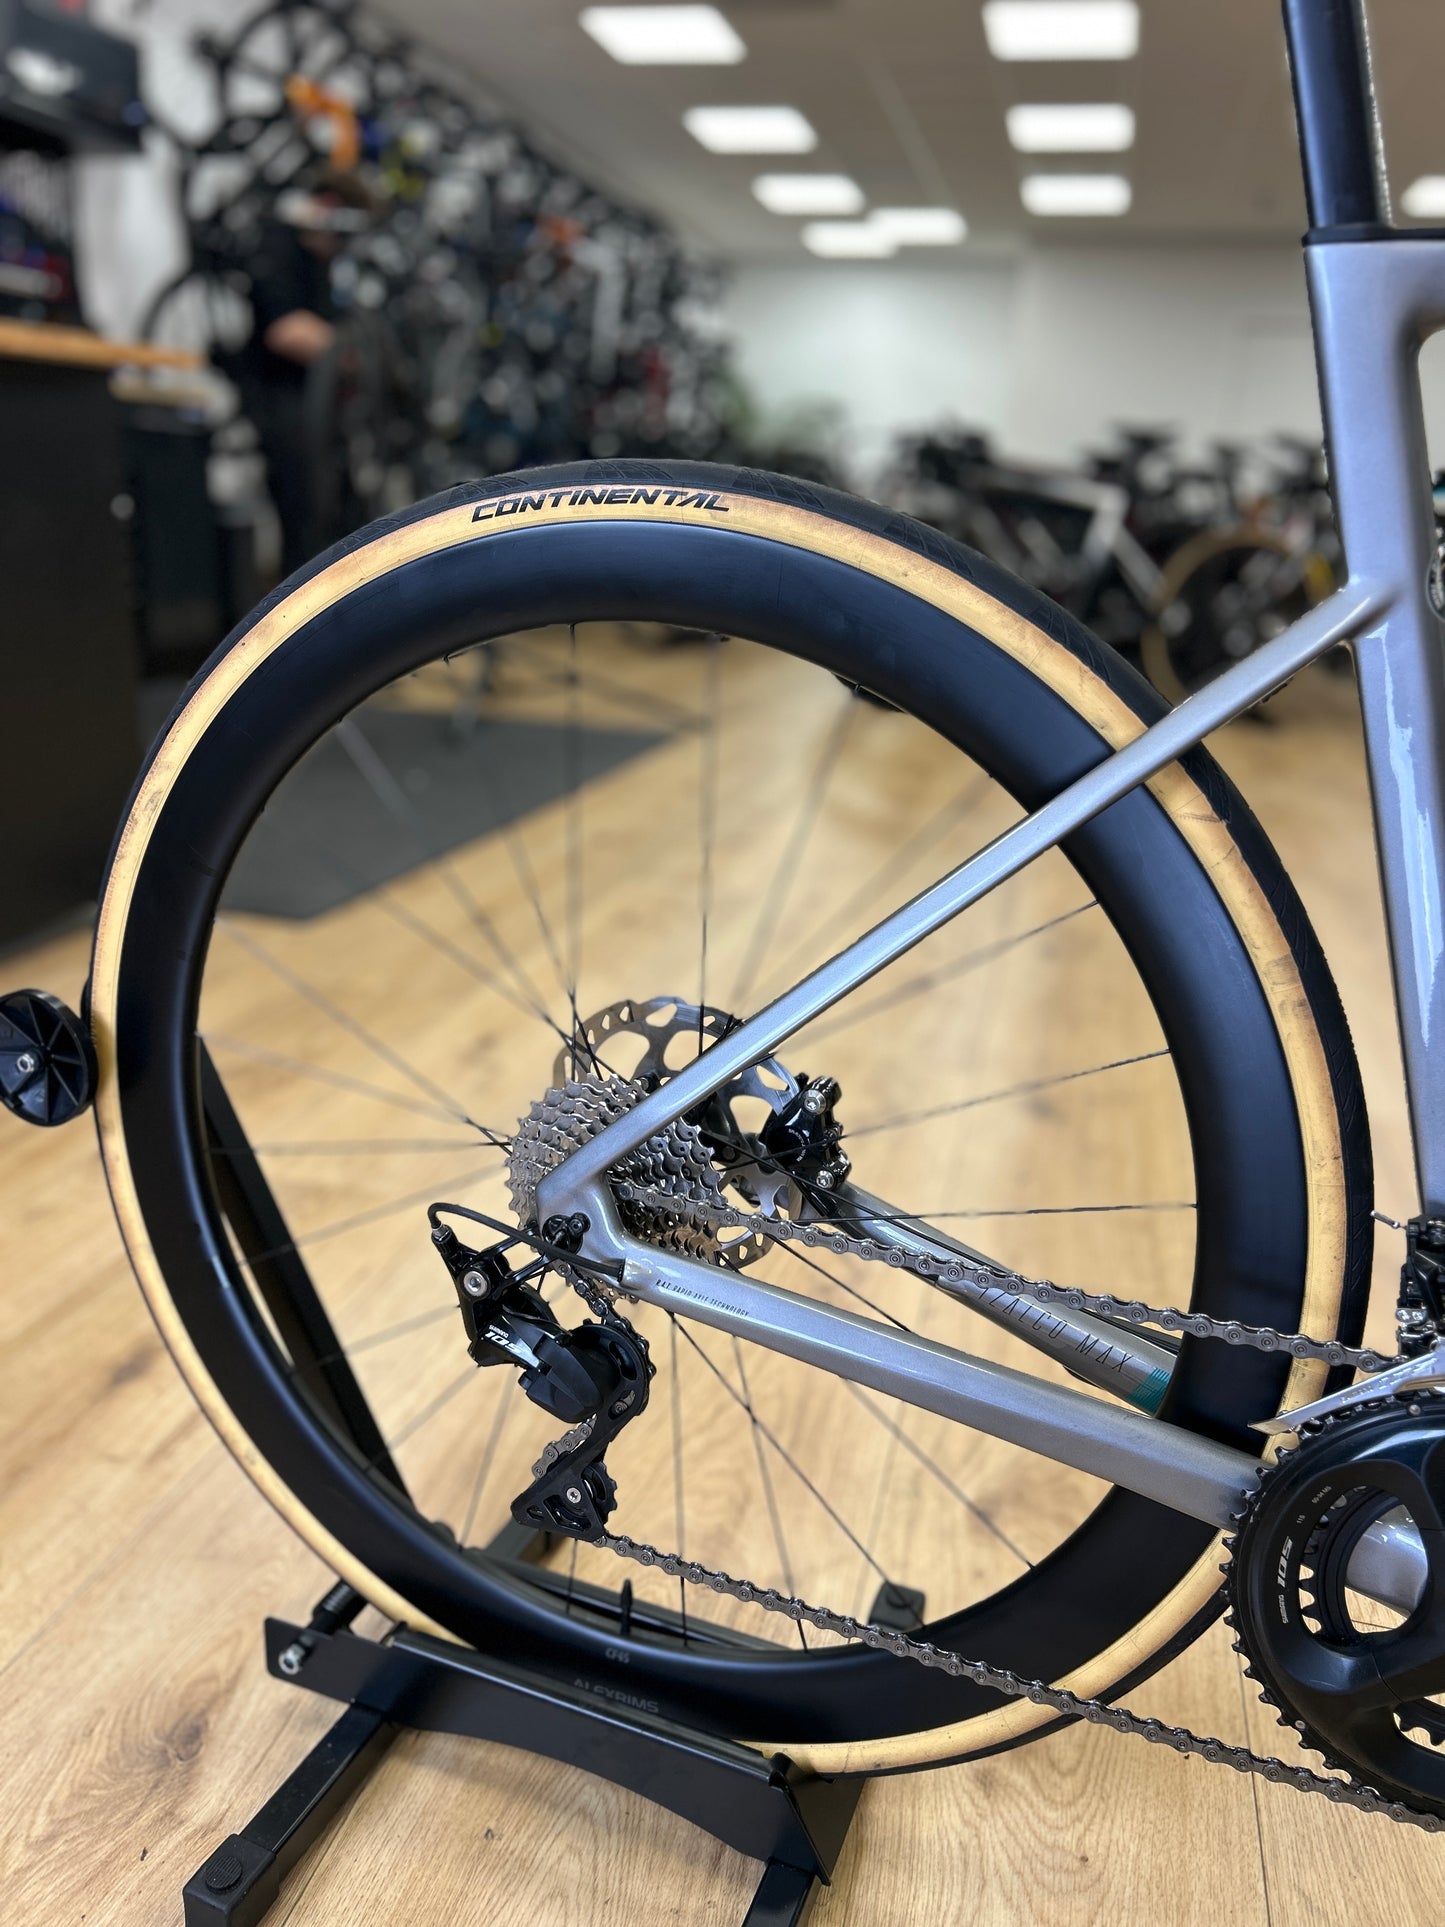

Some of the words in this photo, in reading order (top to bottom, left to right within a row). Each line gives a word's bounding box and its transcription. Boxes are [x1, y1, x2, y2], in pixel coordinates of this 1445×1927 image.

[471, 488, 730, 522] CONTINENTAL
[1075, 1333, 1133, 1373] MAX
[1277, 1535, 1293, 1588] 105
